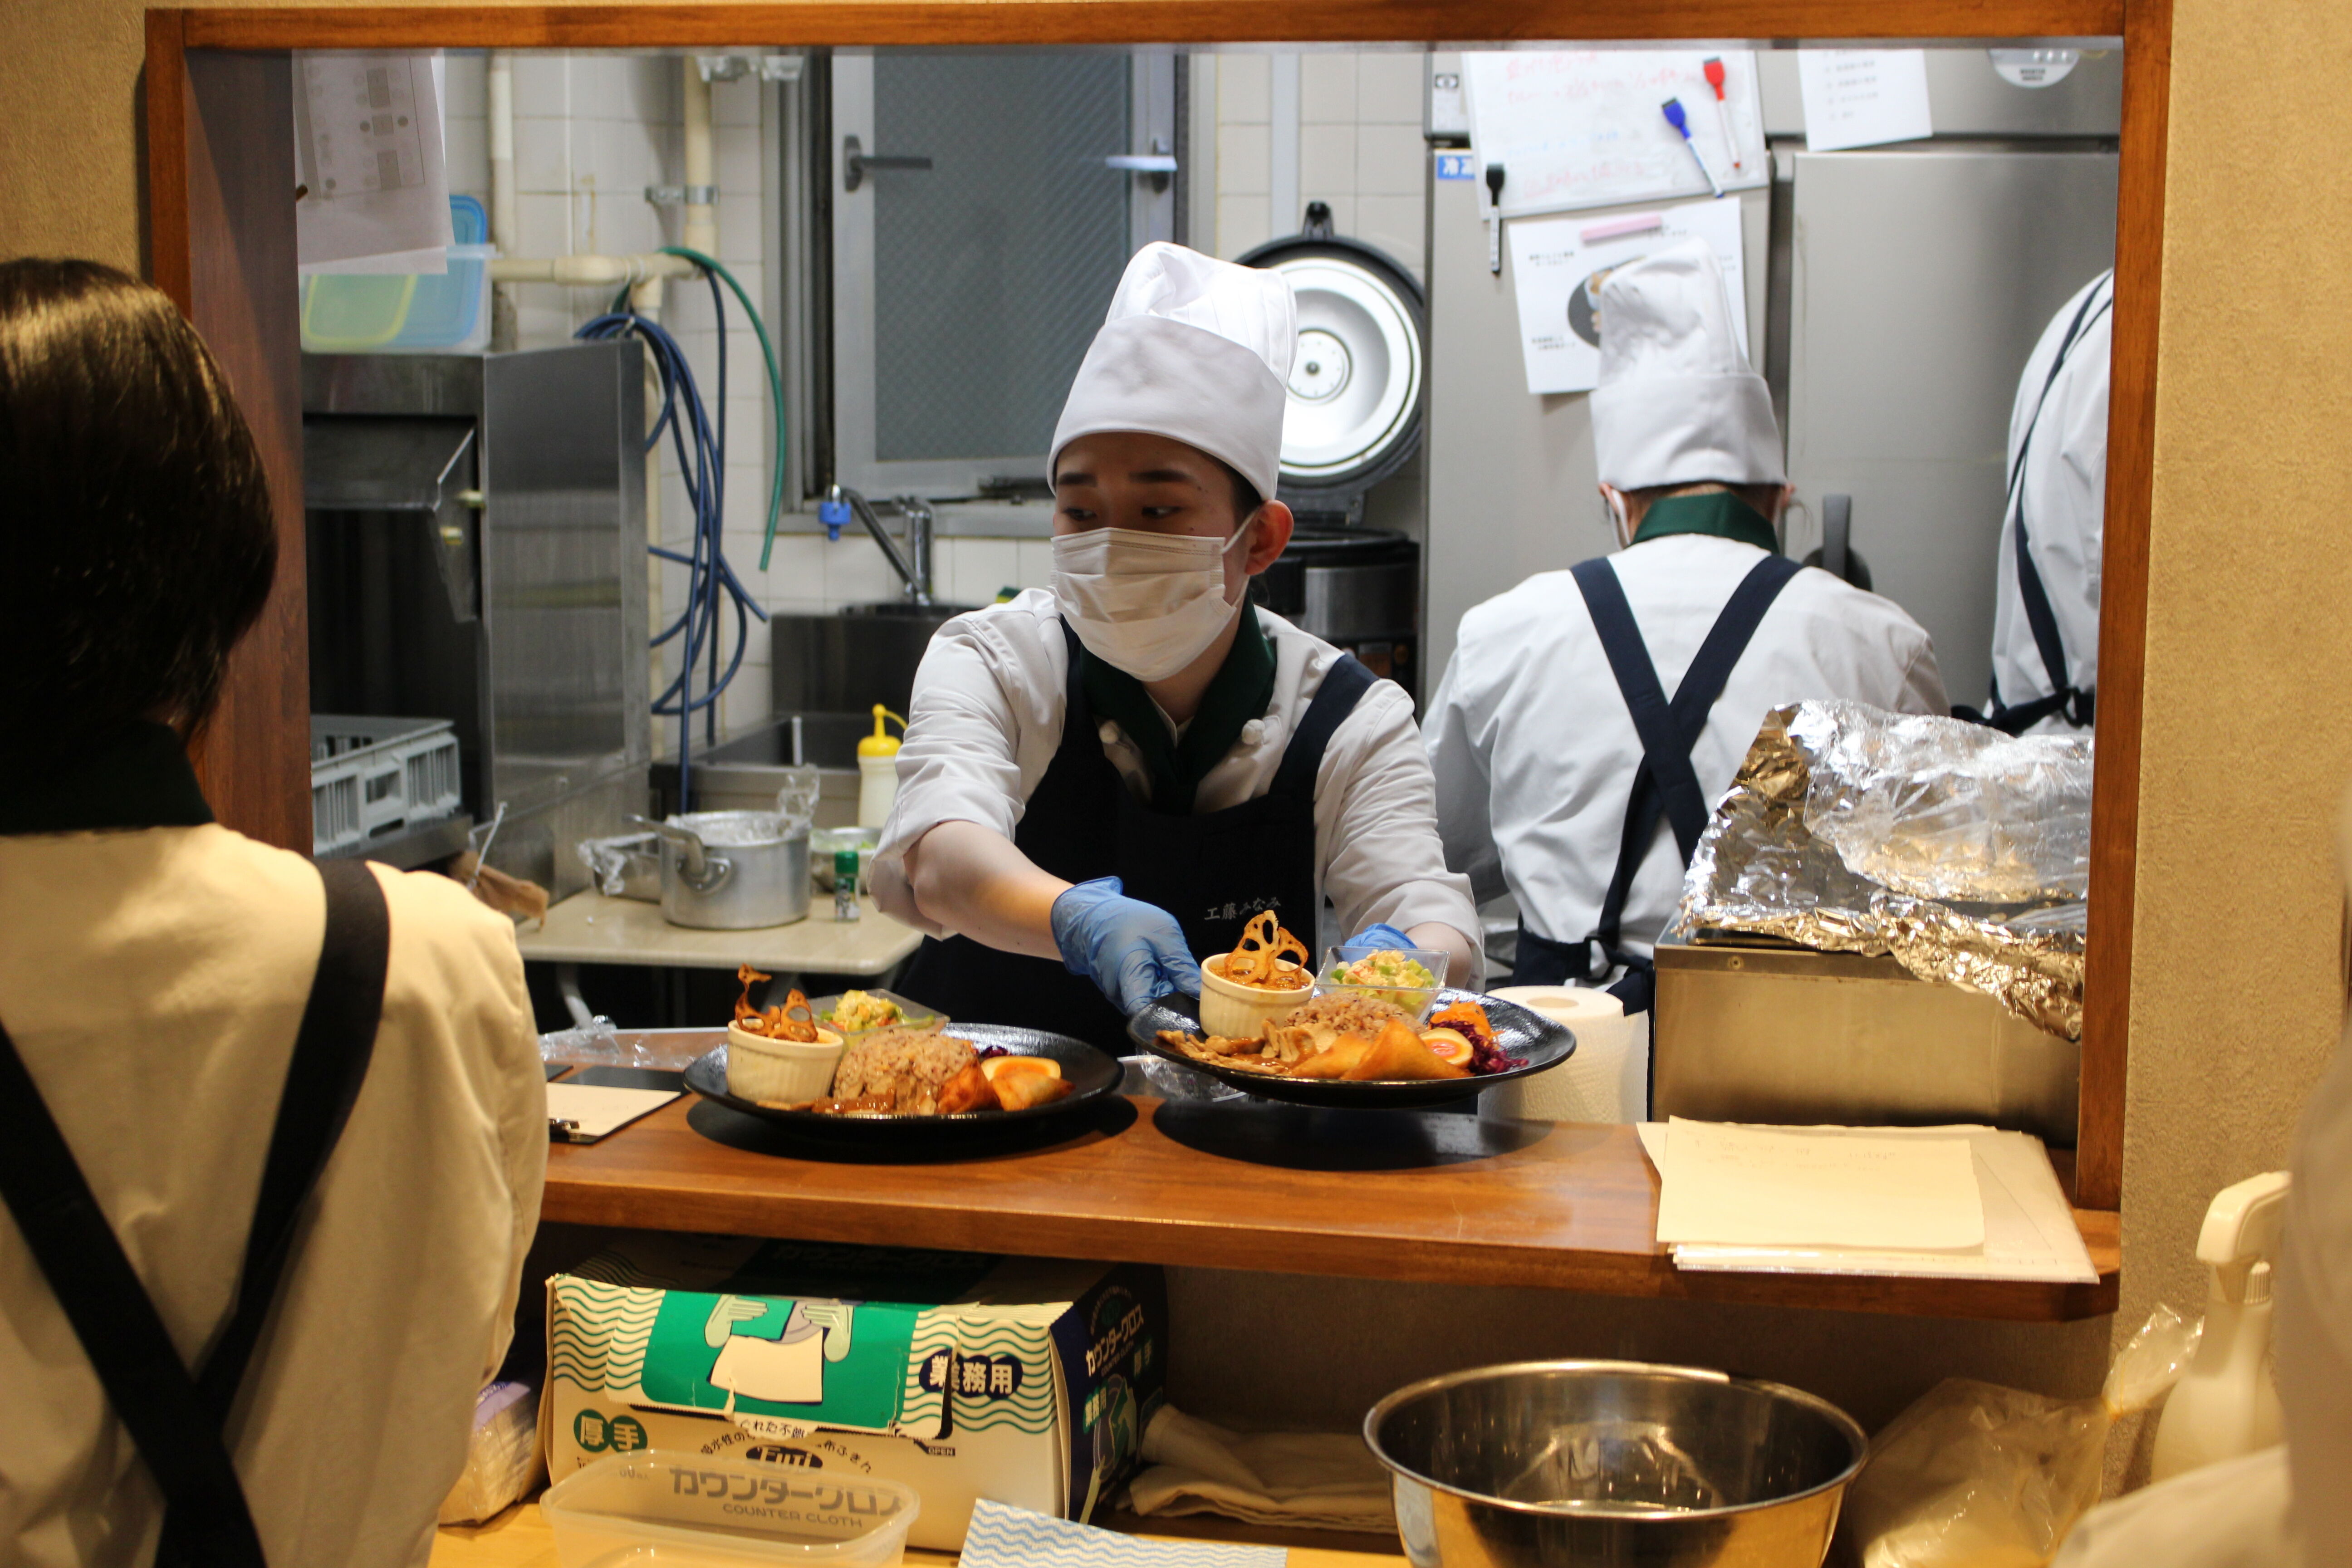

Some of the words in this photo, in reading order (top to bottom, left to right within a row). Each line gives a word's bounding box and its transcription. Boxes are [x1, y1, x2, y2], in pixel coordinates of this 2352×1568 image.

[1086, 1303, 1145, 1377] カウンタークロス
[580, 1415, 639, 1450] 厚手
[928, 1447, 954, 1456] OPEN
[723, 1503, 800, 1521] COUNTER
[806, 1513, 862, 1528] CLOTH
